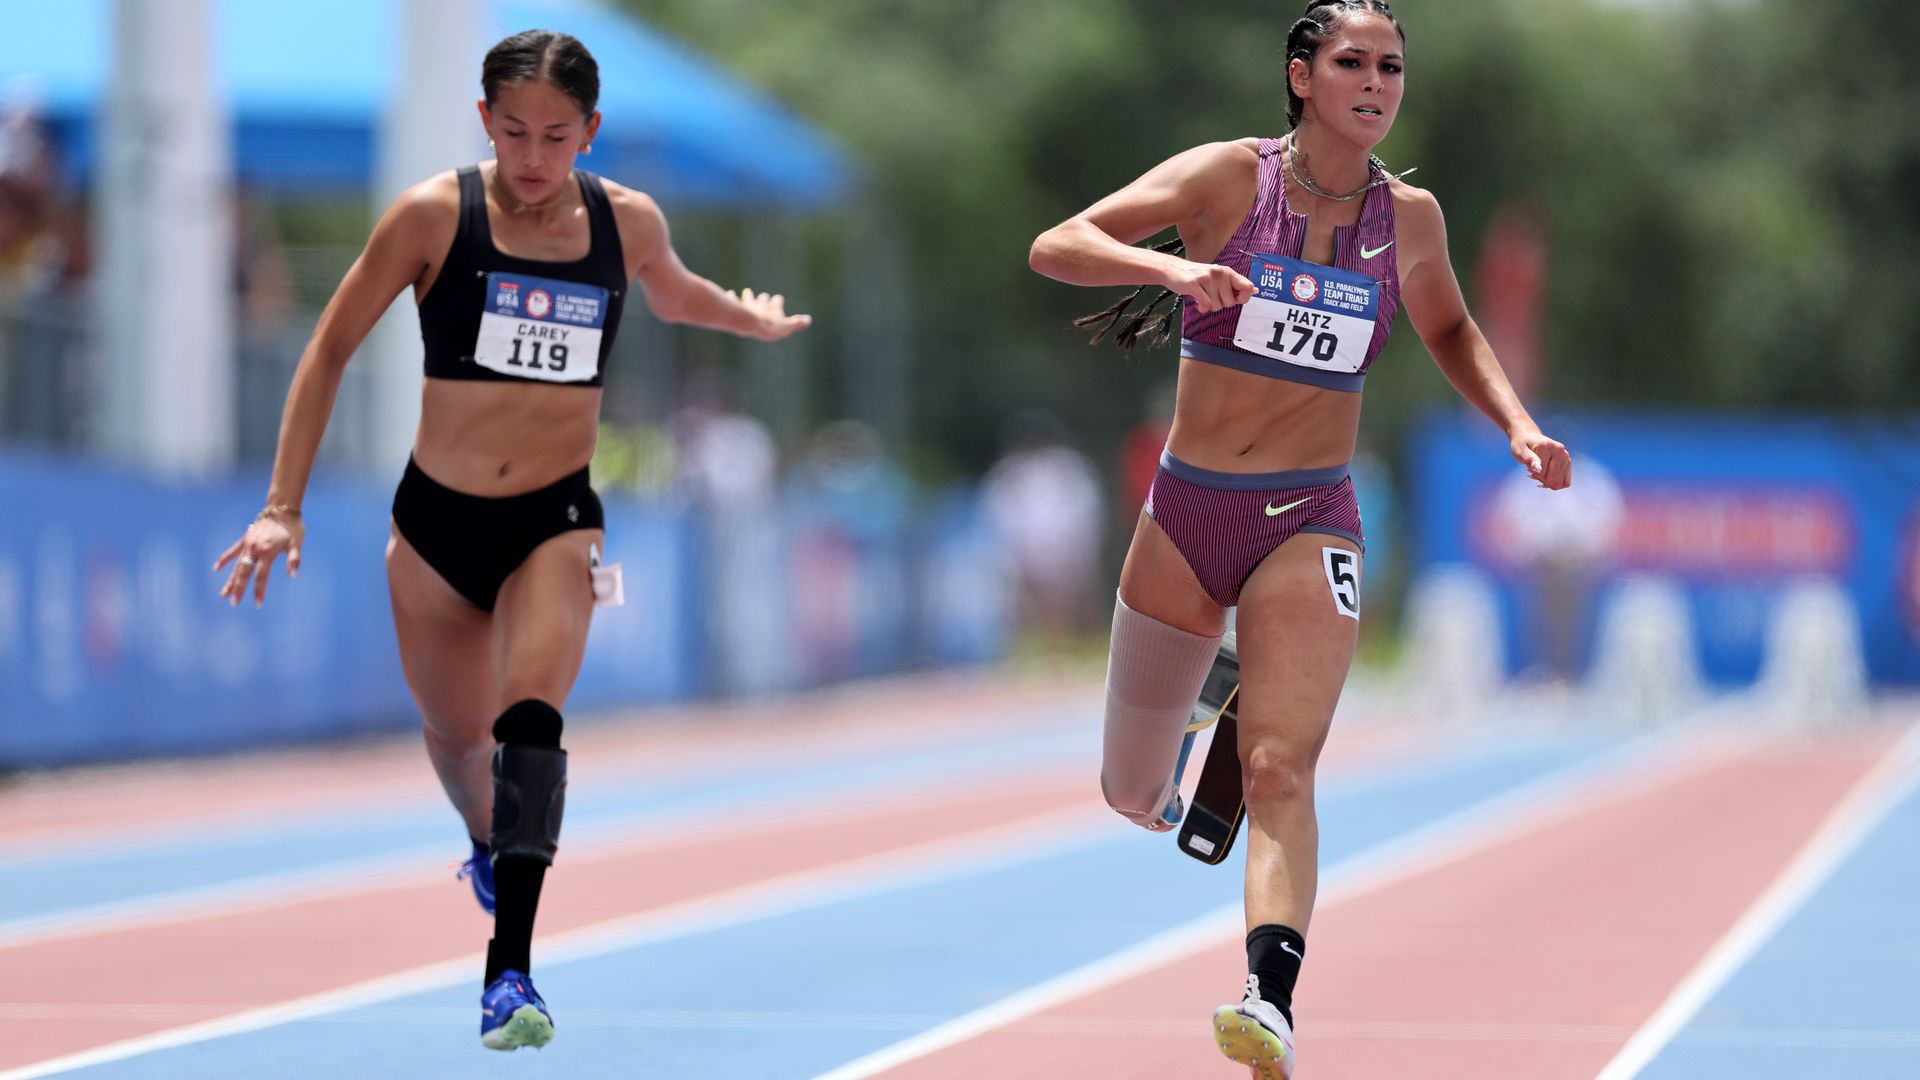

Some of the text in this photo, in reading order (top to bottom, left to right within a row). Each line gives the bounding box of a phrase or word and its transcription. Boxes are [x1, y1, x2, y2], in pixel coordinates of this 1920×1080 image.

[1265, 269, 1282, 277] TEAM
[1260, 275, 1283, 291] USA
[1336, 282, 1370, 296] PARALYMPIC
[496, 292, 519, 309] USA
[1323, 298, 1364, 312] TRACK AND FIELD
[1324, 288, 1369, 305] TEAM TRIALS
[1286, 308, 1332, 330] HATZ
[517, 323, 570, 341] CAREY
[1266, 321, 1339, 362] 170
[507, 338, 569, 372] 119
[1330, 552, 1359, 614] 5
